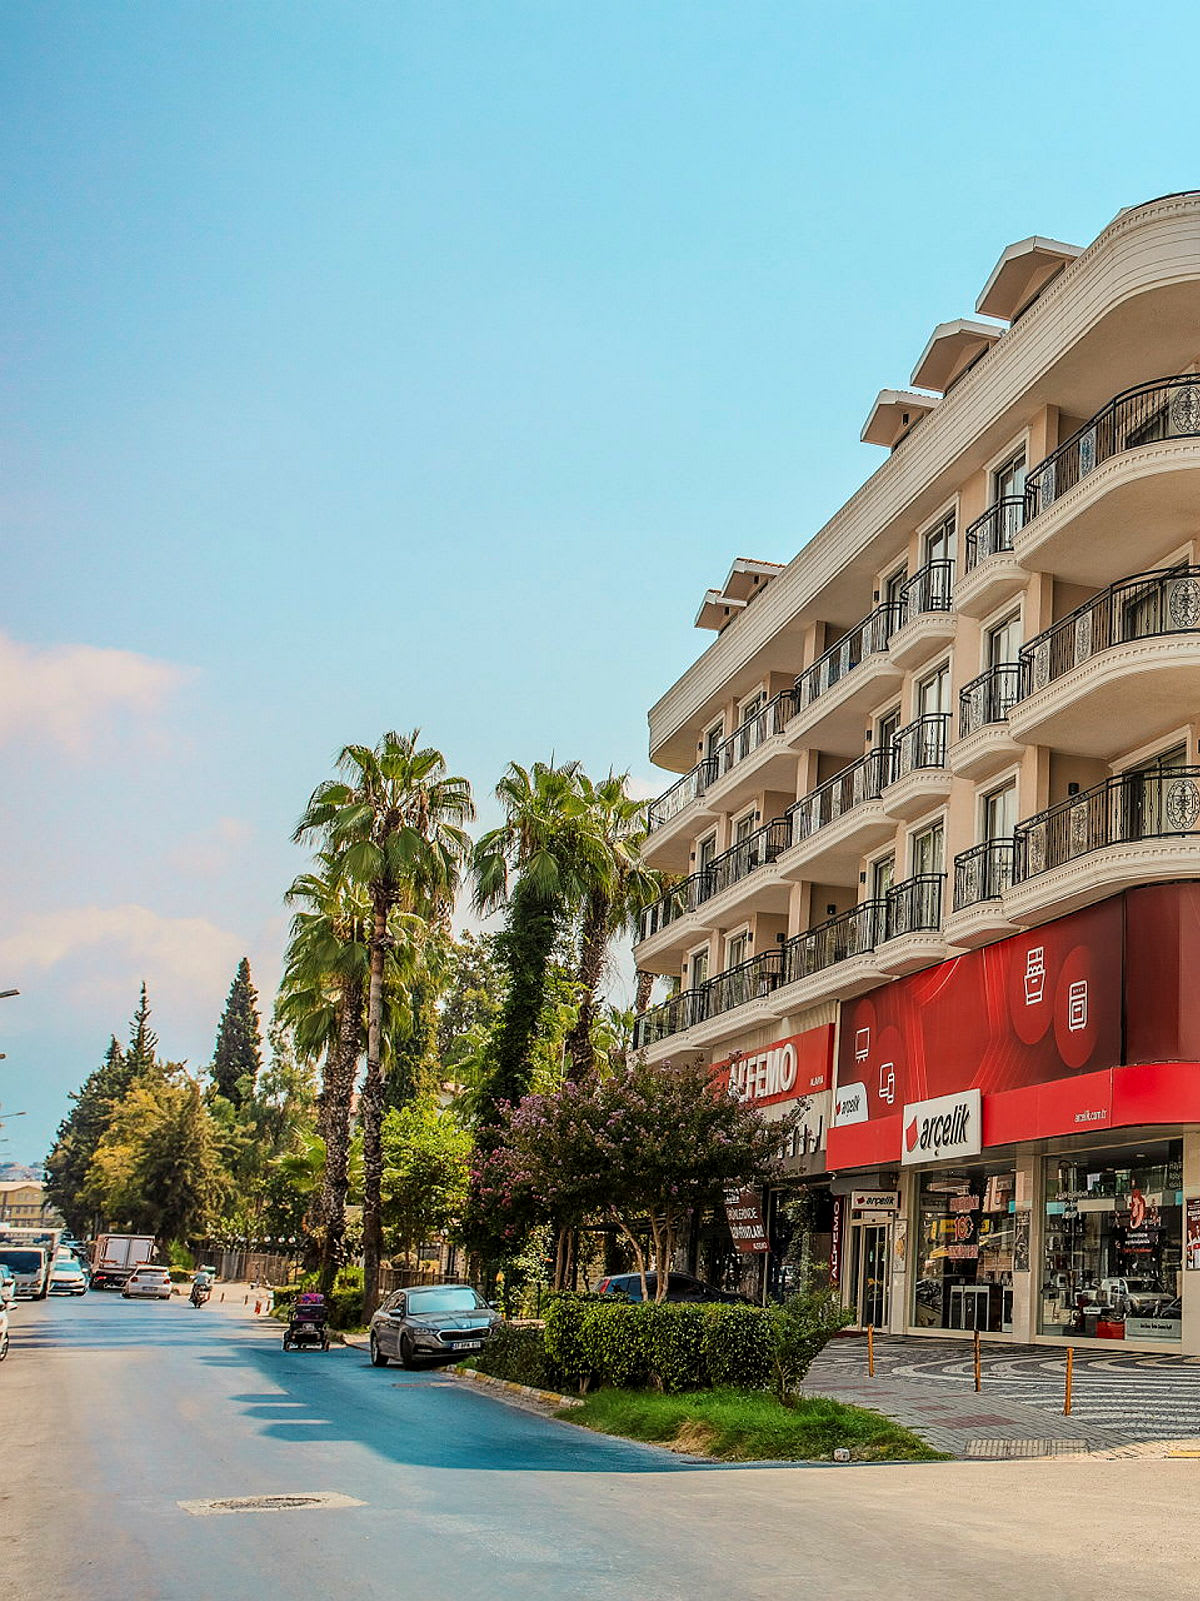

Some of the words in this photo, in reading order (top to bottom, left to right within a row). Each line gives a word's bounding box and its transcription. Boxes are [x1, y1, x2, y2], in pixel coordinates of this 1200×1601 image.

[841, 1095, 860, 1117] arçelik
[920, 1104, 970, 1157] arçelik
[866, 1195, 895, 1206] arçelik
[831, 1201, 840, 1279] ALFEMO
